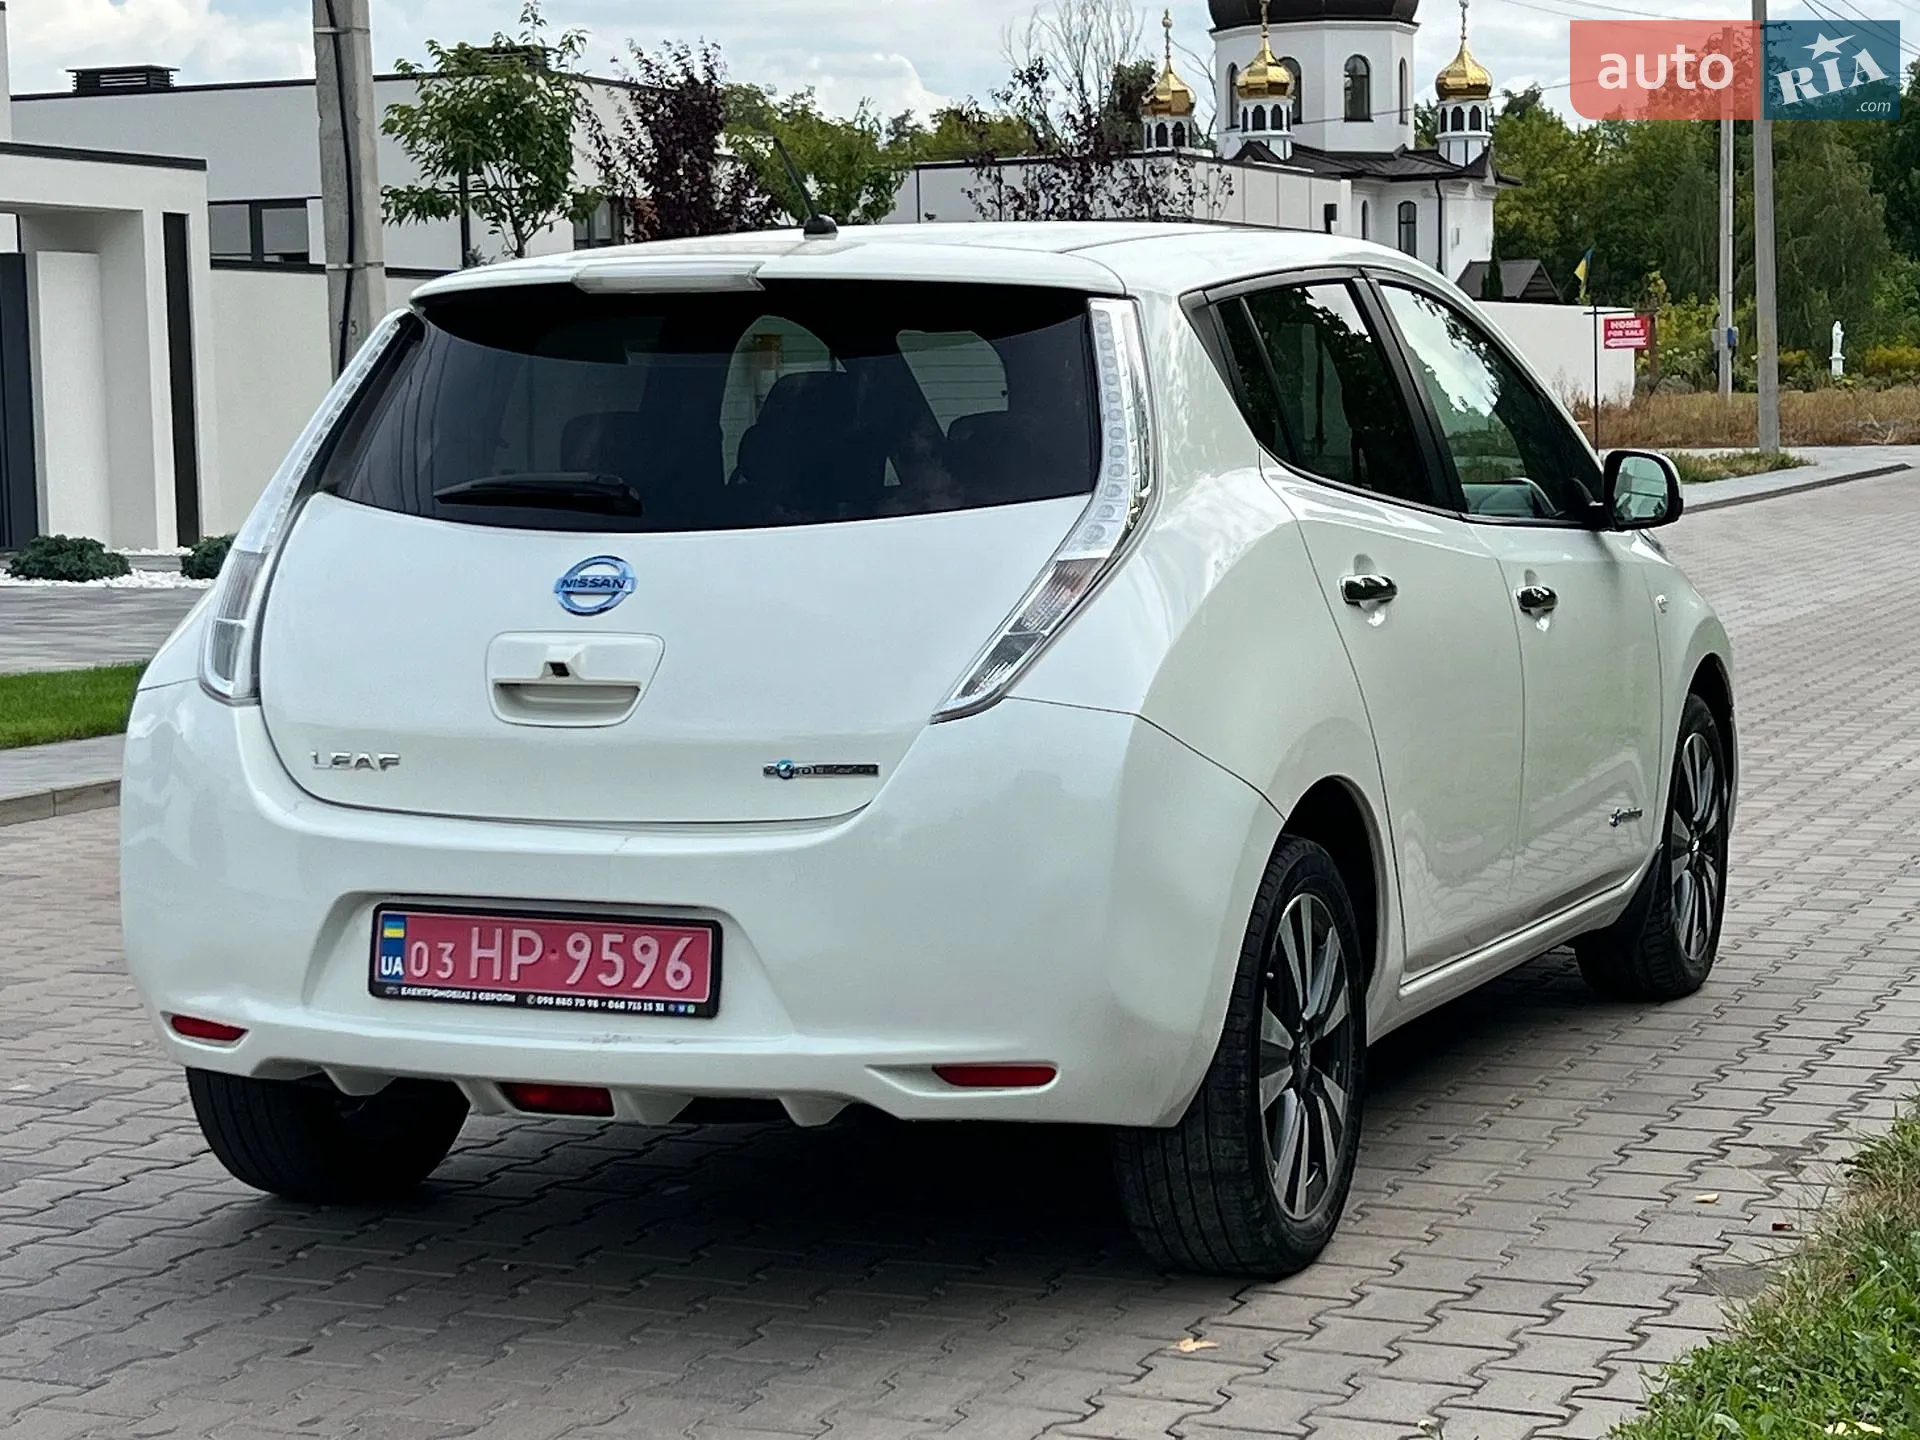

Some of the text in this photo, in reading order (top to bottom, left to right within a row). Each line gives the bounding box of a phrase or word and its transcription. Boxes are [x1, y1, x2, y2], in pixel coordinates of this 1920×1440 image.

[1610, 320, 1641, 330] HOME
[1607, 329, 1645, 337] FOR SALE
[561, 578, 625, 589] NISSAN
[310, 751, 400, 772] LEAF
[381, 956, 404, 976] UA
[410, 926, 693, 991] 03 HP 9596
